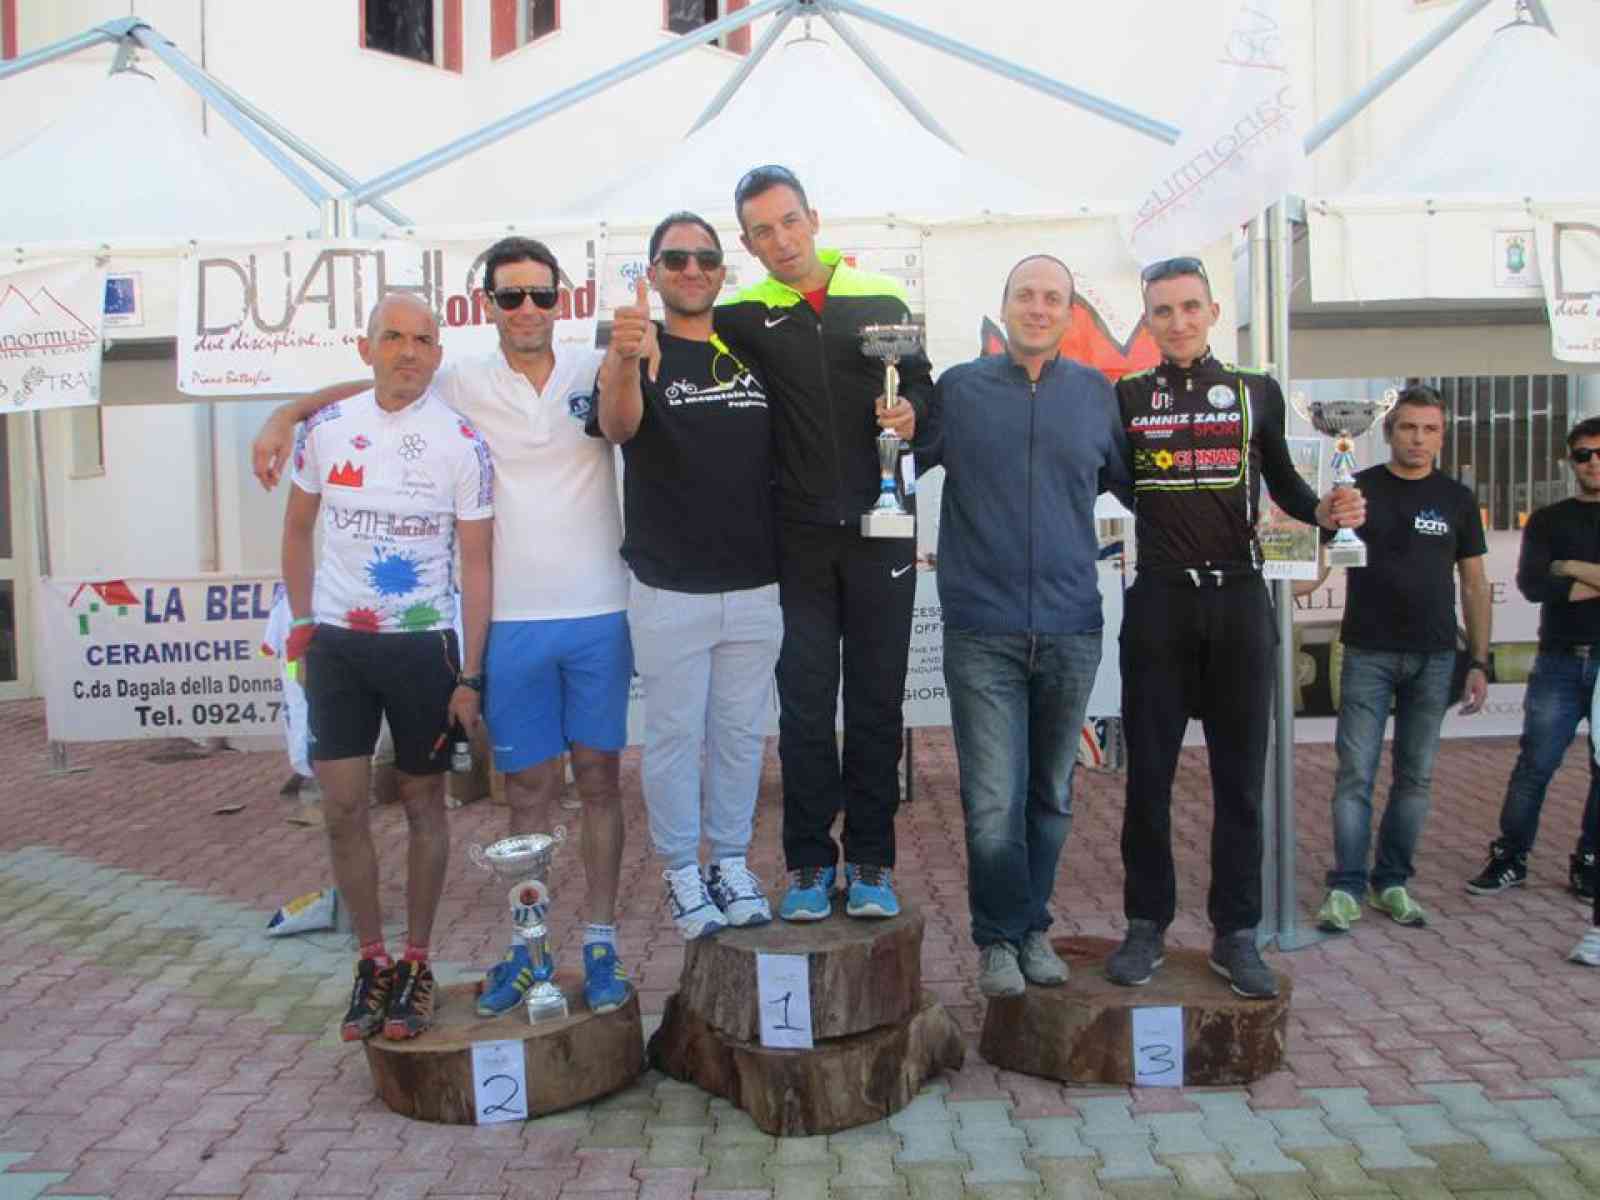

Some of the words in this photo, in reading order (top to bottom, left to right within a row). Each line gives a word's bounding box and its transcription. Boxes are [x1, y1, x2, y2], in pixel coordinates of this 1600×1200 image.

[197, 240, 596, 337] DUATHL
[194, 334, 224, 351] due
[144, 587, 186, 624] LA
[86, 639, 250, 666] CERAMICHE
[73, 680, 111, 699] C.da
[117, 676, 176, 702] Dagala
[180, 675, 223, 695] della
[228, 674, 284, 693] Donna
[134, 705, 183, 727] Tel.
[768, 991, 805, 1031] 1
[1138, 1043, 1176, 1076] 3
[482, 1073, 522, 1116] 2
